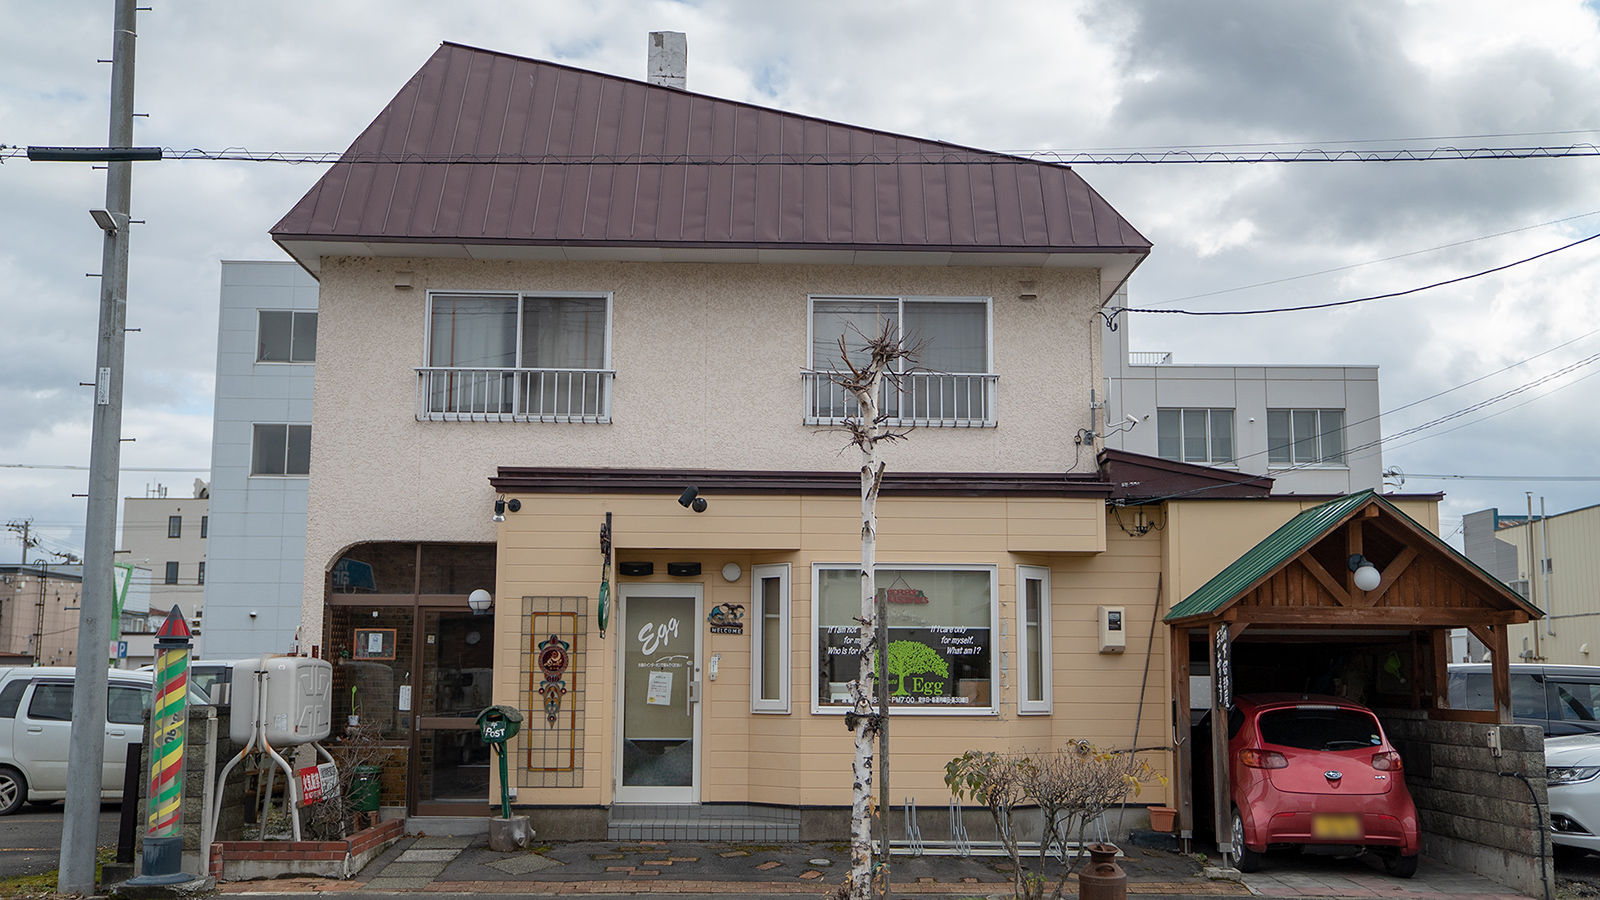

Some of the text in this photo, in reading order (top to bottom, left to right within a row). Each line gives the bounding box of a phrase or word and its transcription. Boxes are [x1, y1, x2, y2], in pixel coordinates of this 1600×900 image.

[638, 617, 681, 656] Egg
[844, 635, 855, 645] for
[941, 635, 951, 645] for
[118, 642, 126, 657] P
[828, 646, 842, 655] Who
[842, 646, 848, 655] is
[848, 646, 859, 655] for
[946, 646, 963, 655] What
[912, 677, 944, 696] Egg
